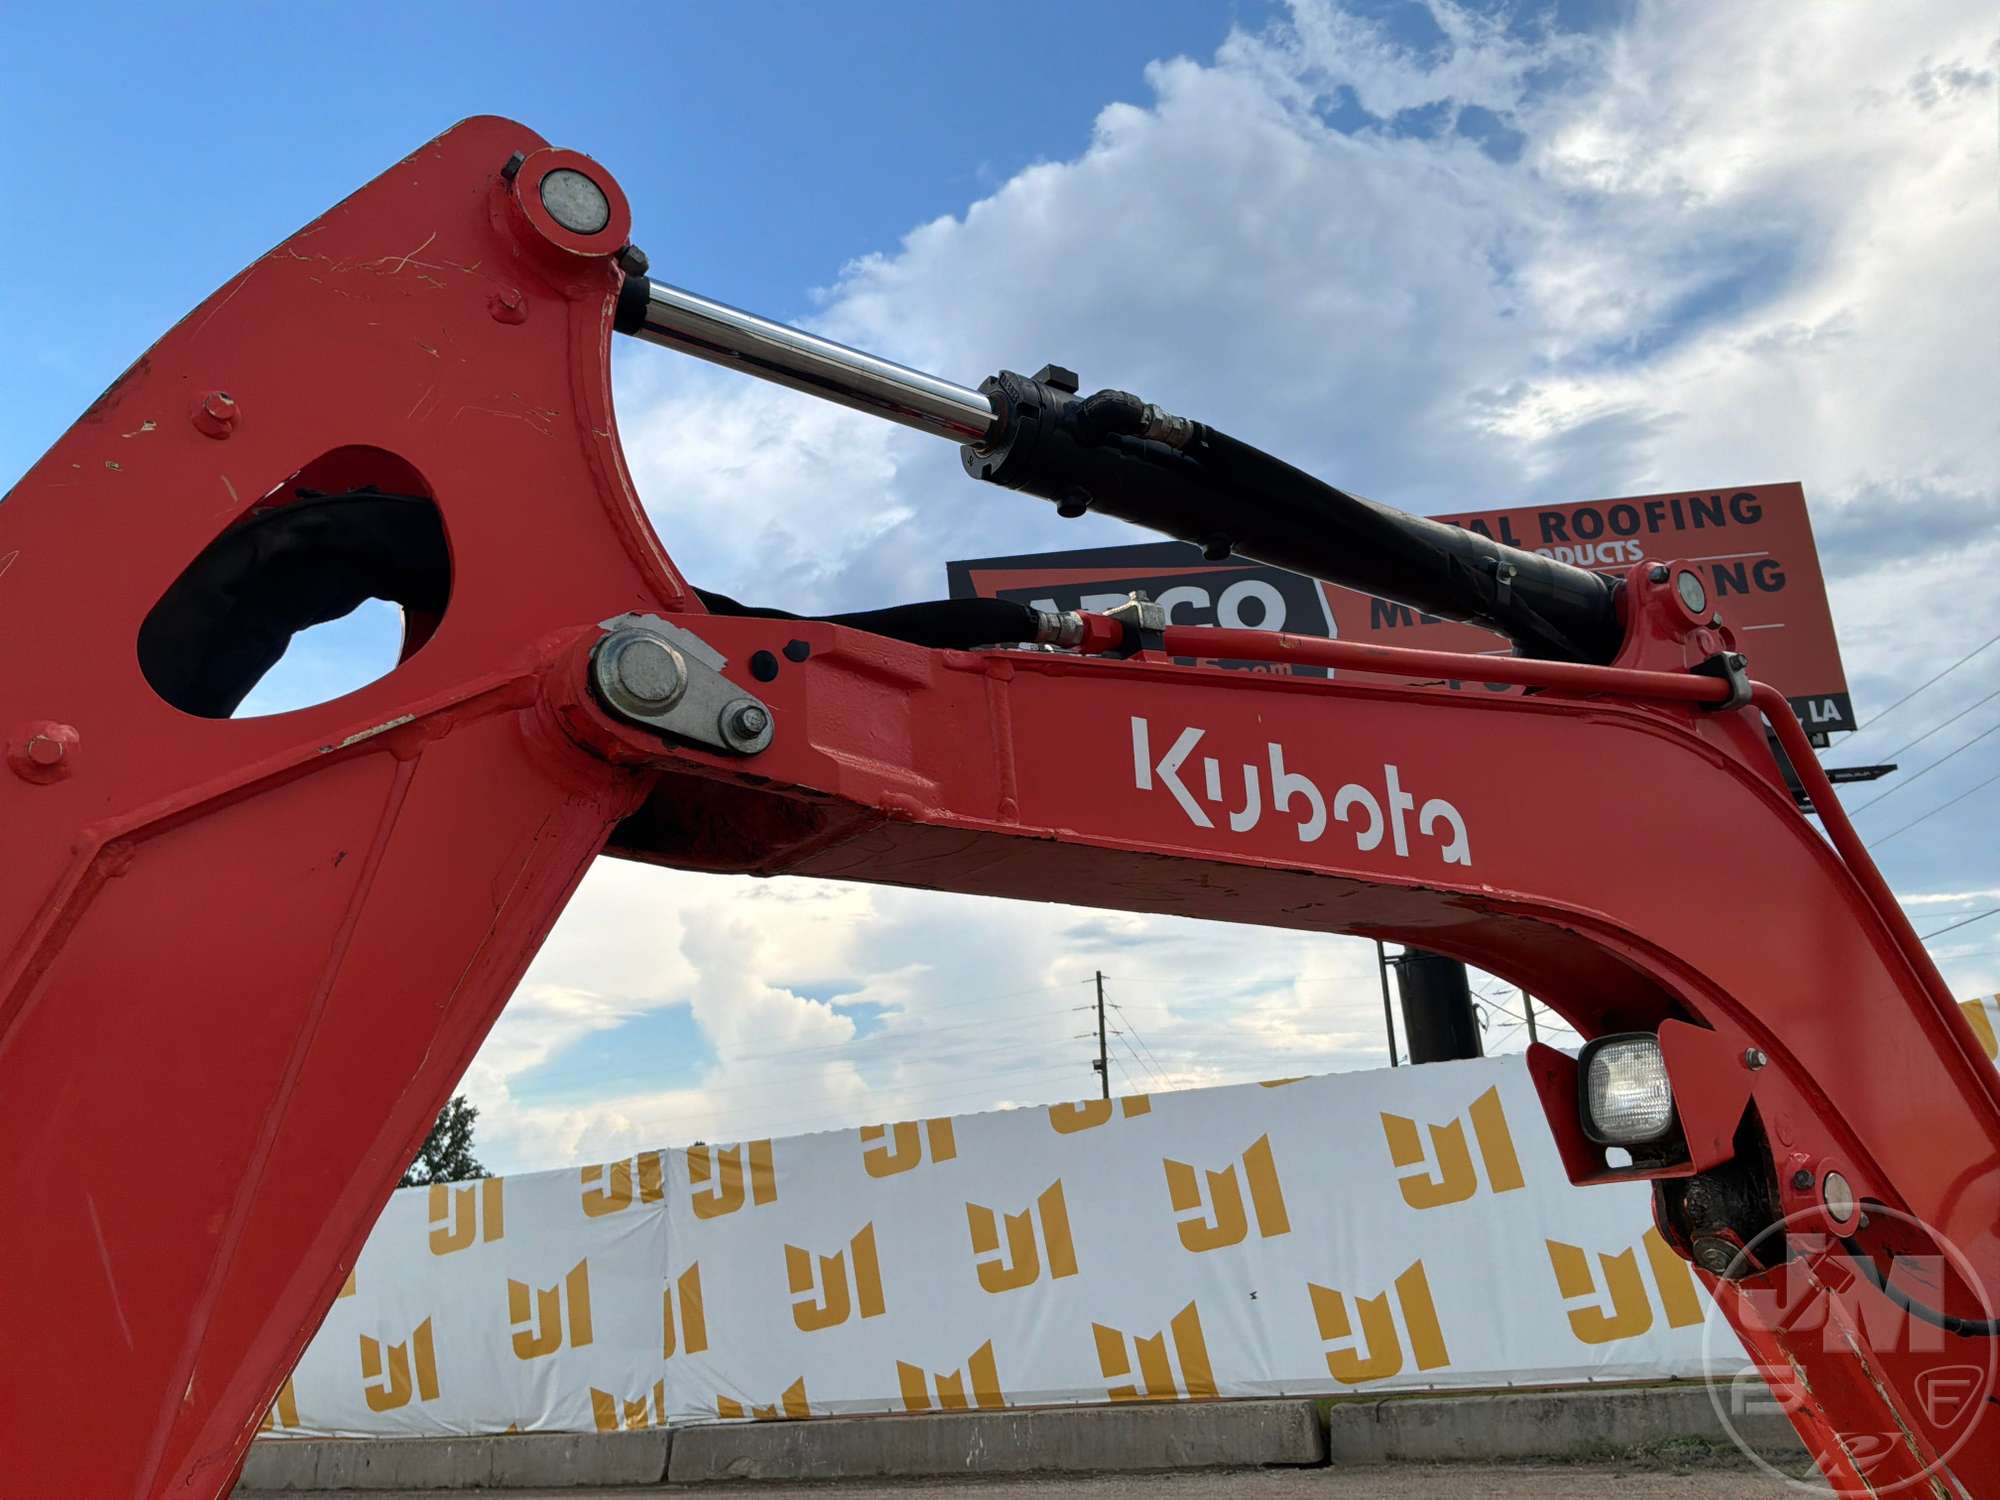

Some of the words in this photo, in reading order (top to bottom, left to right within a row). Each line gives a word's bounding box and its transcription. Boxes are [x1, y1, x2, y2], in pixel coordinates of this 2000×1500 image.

[1539, 492, 1763, 545] ROOFING
[1808, 699, 1842, 723] LA
[1131, 715, 1472, 867] Kubota
